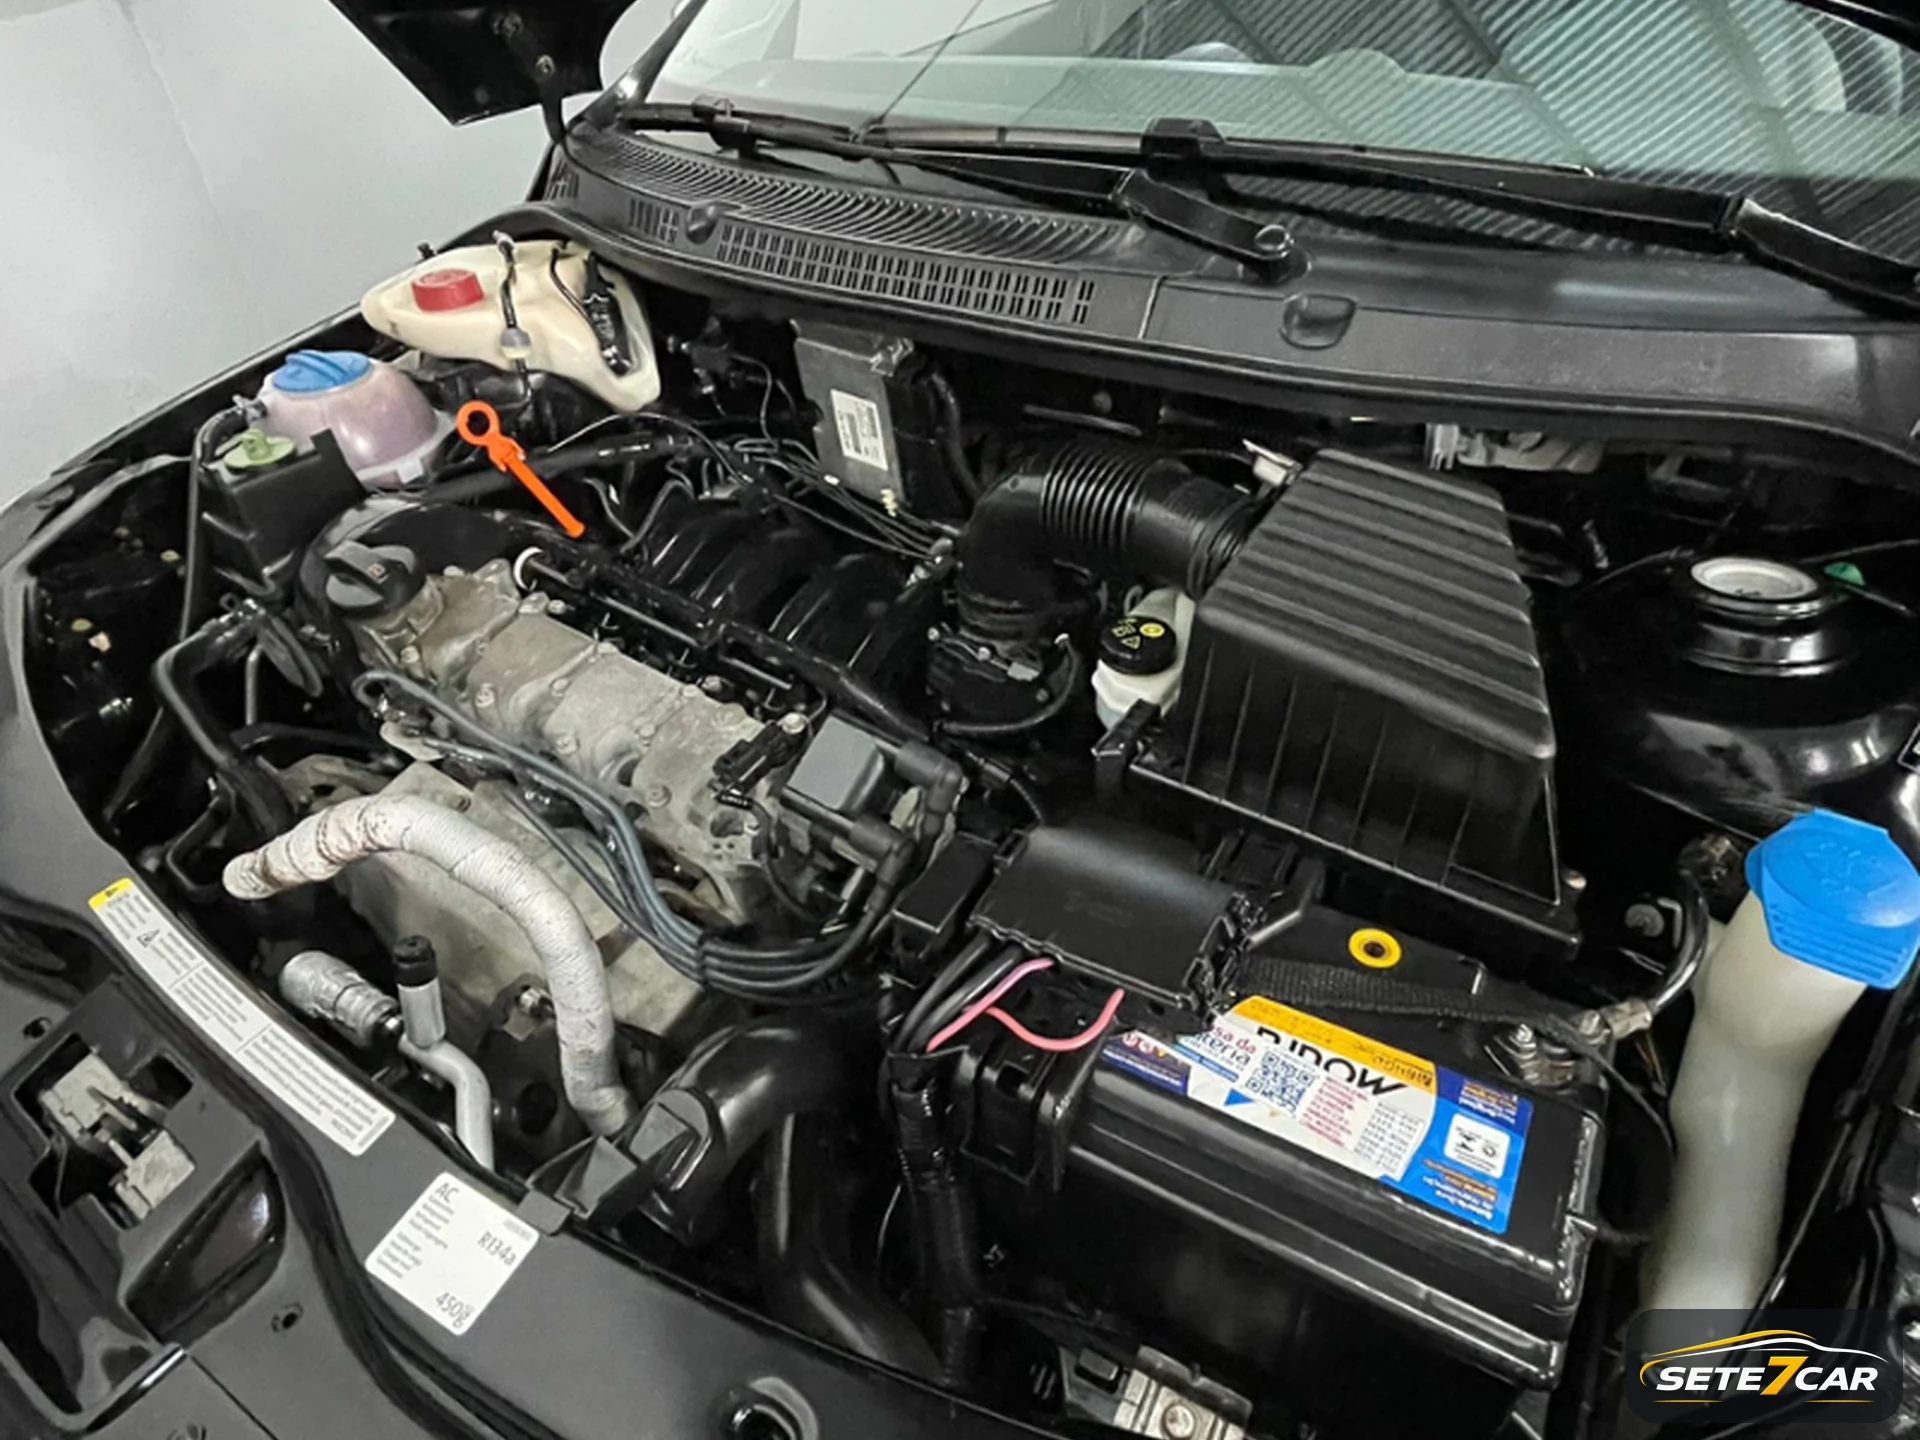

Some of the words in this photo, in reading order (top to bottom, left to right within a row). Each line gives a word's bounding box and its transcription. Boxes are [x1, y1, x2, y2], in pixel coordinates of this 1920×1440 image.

[1197, 1033, 1251, 1065] teria
[1211, 1025, 1234, 1042] sa
[1237, 1037, 1256, 1055] da
[434, 1182, 460, 1203] AC
[476, 1230, 517, 1266] R134a
[435, 1292, 472, 1329] 450g
